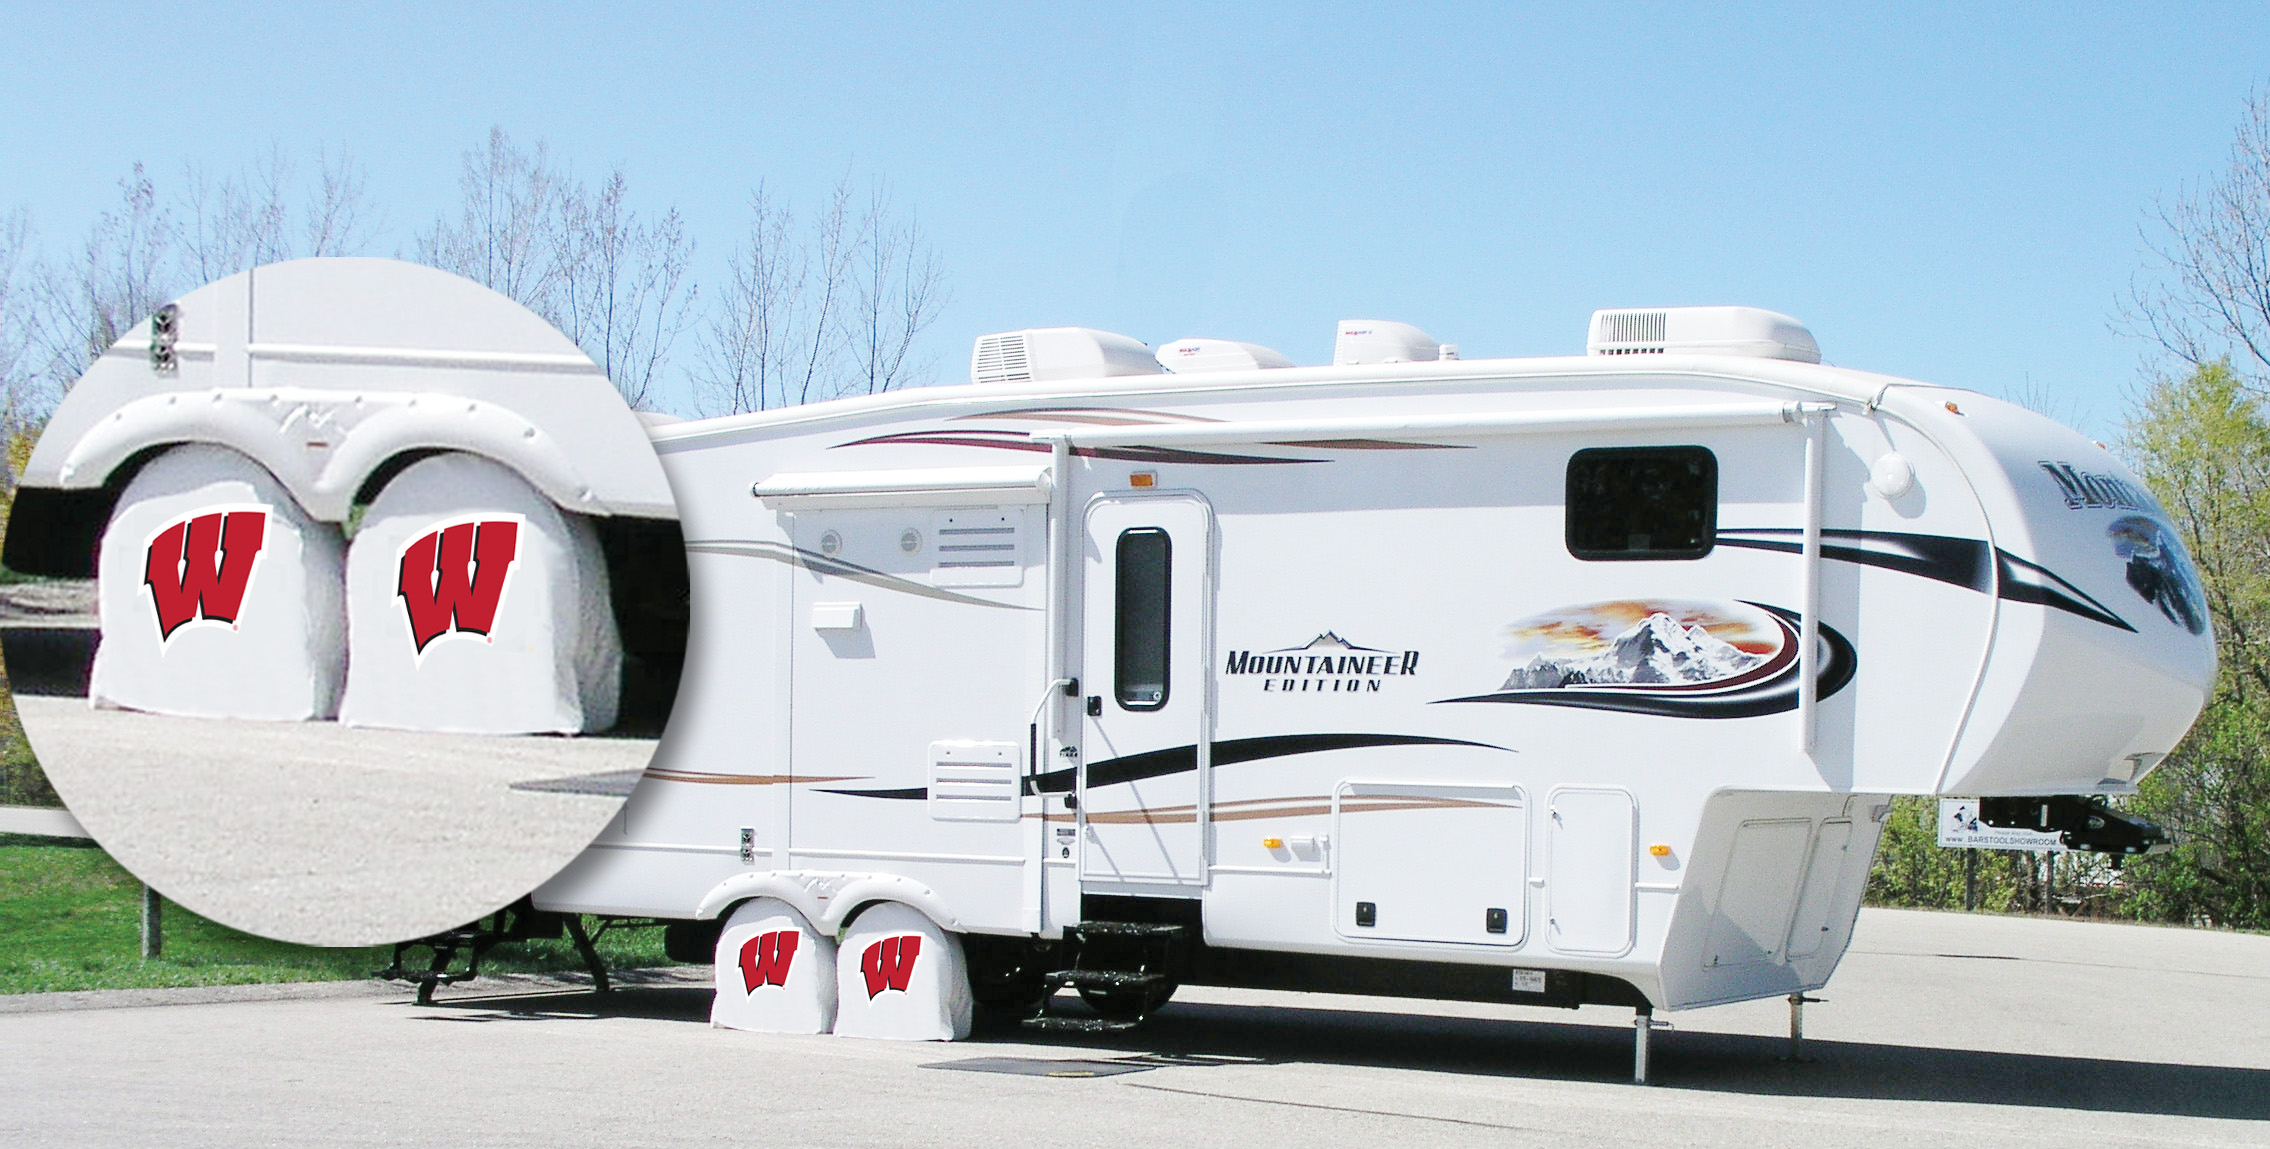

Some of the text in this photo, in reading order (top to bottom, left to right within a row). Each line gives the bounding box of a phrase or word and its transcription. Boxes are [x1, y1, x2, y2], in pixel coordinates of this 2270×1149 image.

[142, 511, 267, 643] W
[396, 521, 519, 656] W
[1226, 650, 1420, 676] MOUNTAINEER
[1263, 678, 1382, 692] EDITION
[738, 930, 800, 996] W
[860, 935, 922, 1001] W
